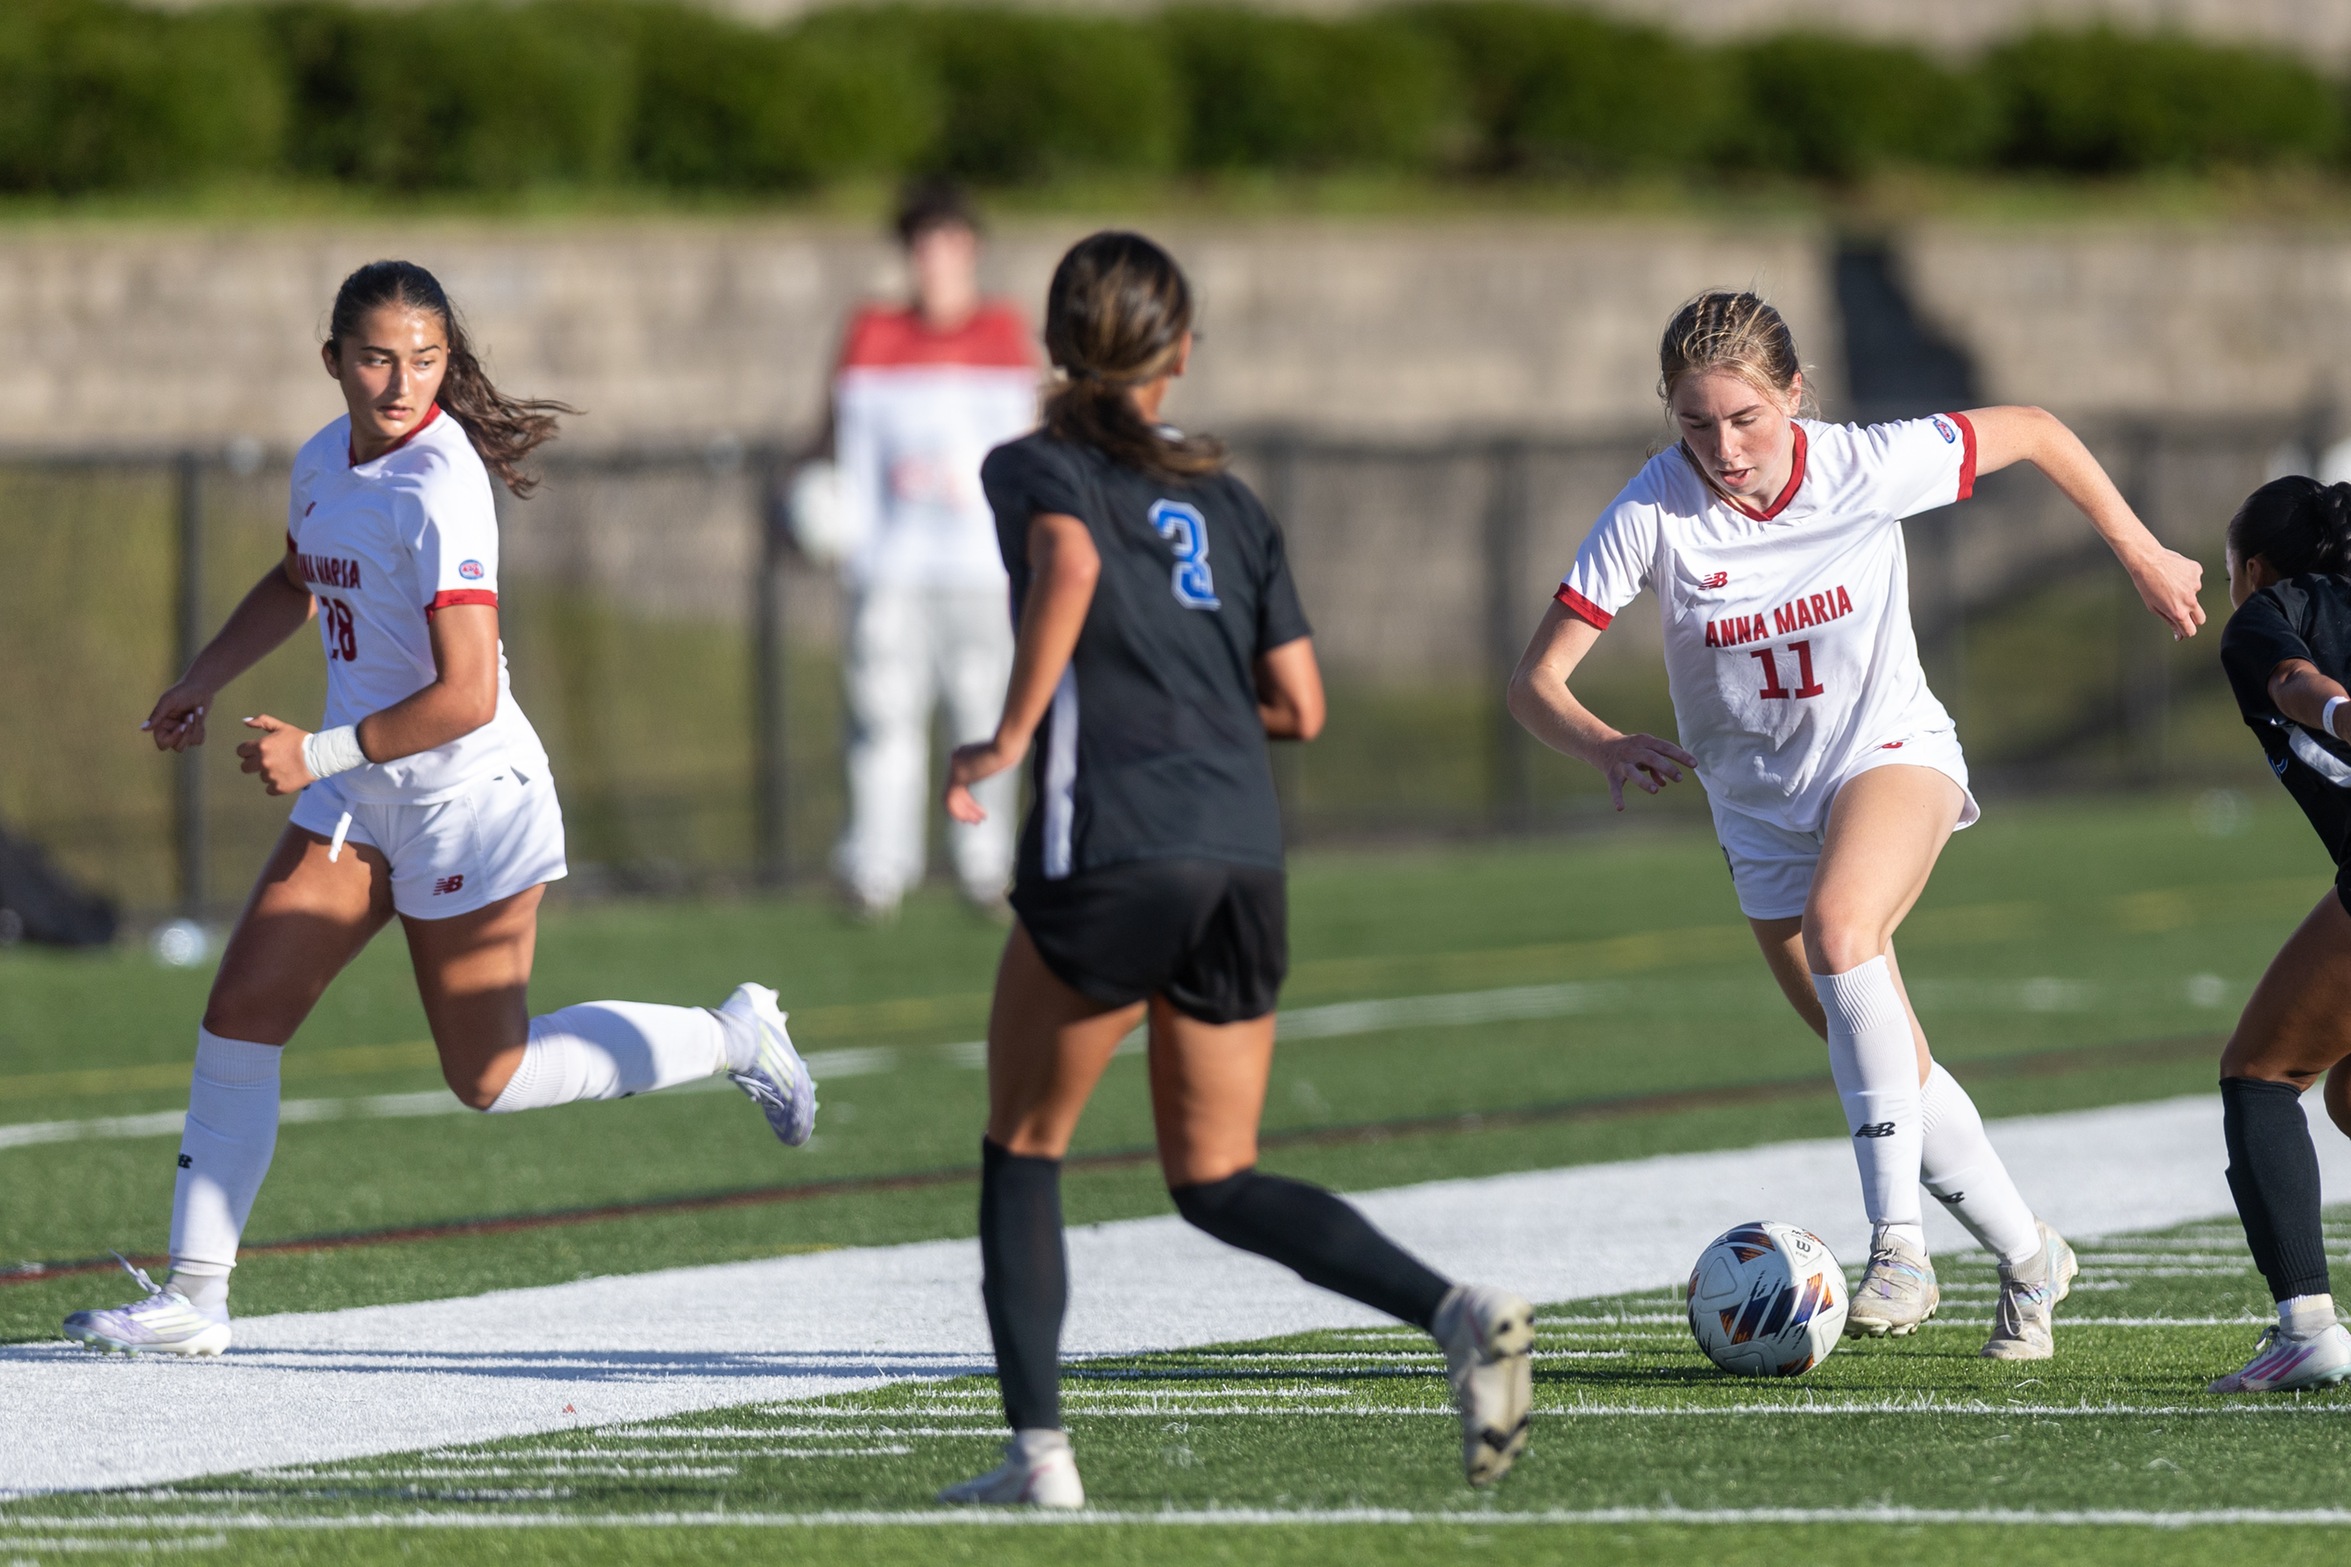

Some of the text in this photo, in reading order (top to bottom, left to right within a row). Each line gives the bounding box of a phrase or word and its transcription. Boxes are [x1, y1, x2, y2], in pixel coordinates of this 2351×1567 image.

[1705, 585, 1853, 648] ANNA MARIA
[1751, 640, 1824, 700] 11
